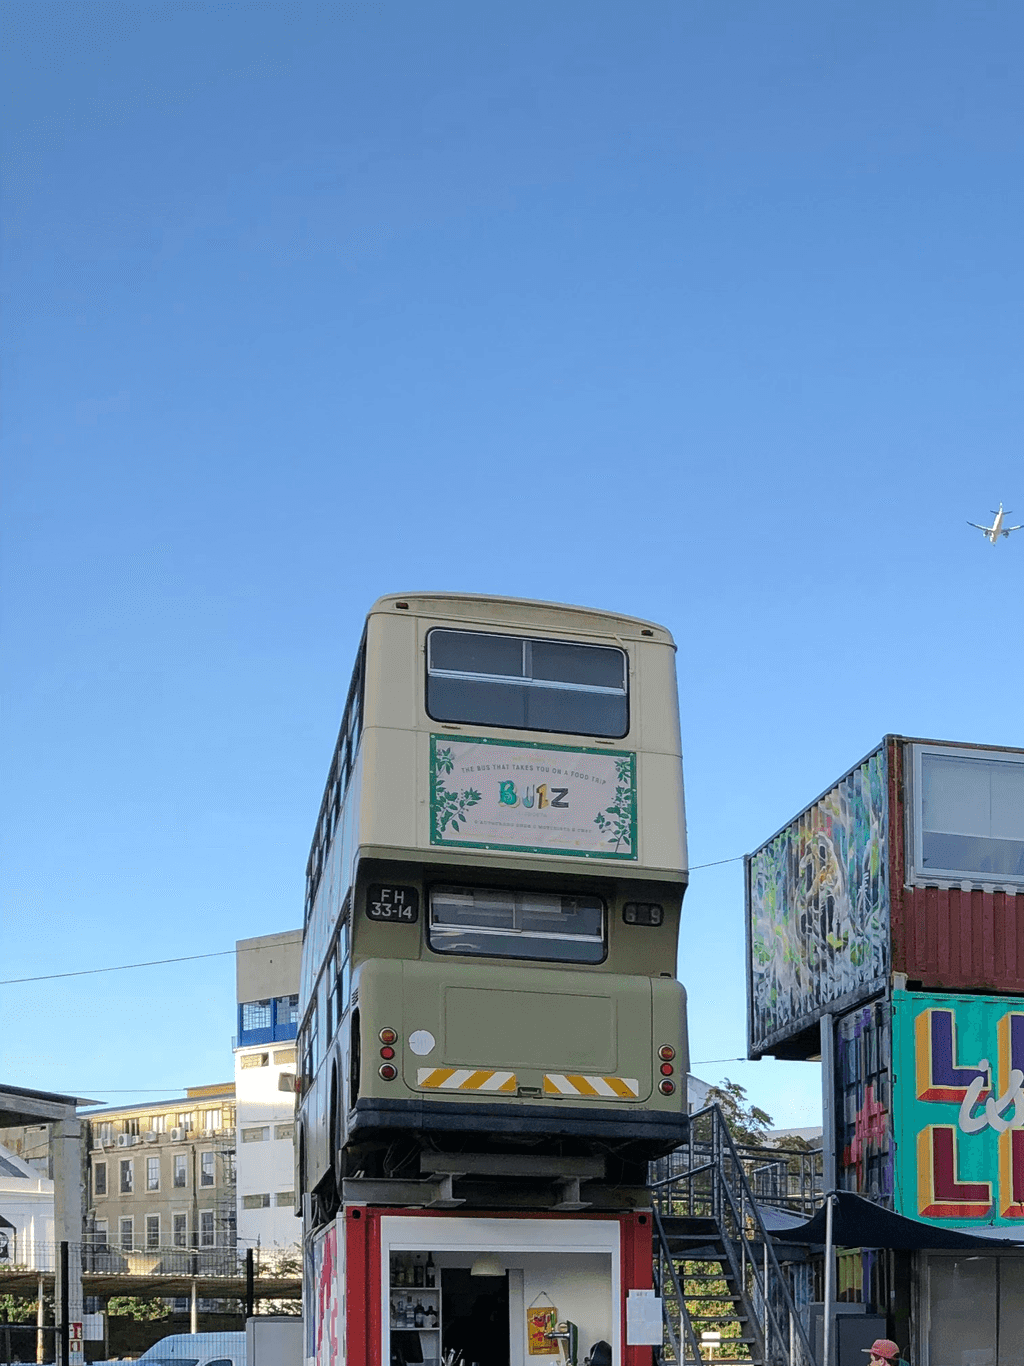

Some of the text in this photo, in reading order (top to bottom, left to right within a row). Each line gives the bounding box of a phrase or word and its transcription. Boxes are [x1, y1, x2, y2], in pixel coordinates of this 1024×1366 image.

[461, 765, 475, 774] THE
[477, 764, 491, 772] BUS
[536, 765, 550, 773] YOU
[571, 771, 589, 780] FOOD
[591, 776, 607, 785] TRIP
[381, 889, 405, 904] FH
[371, 902, 412, 919] 33-14
